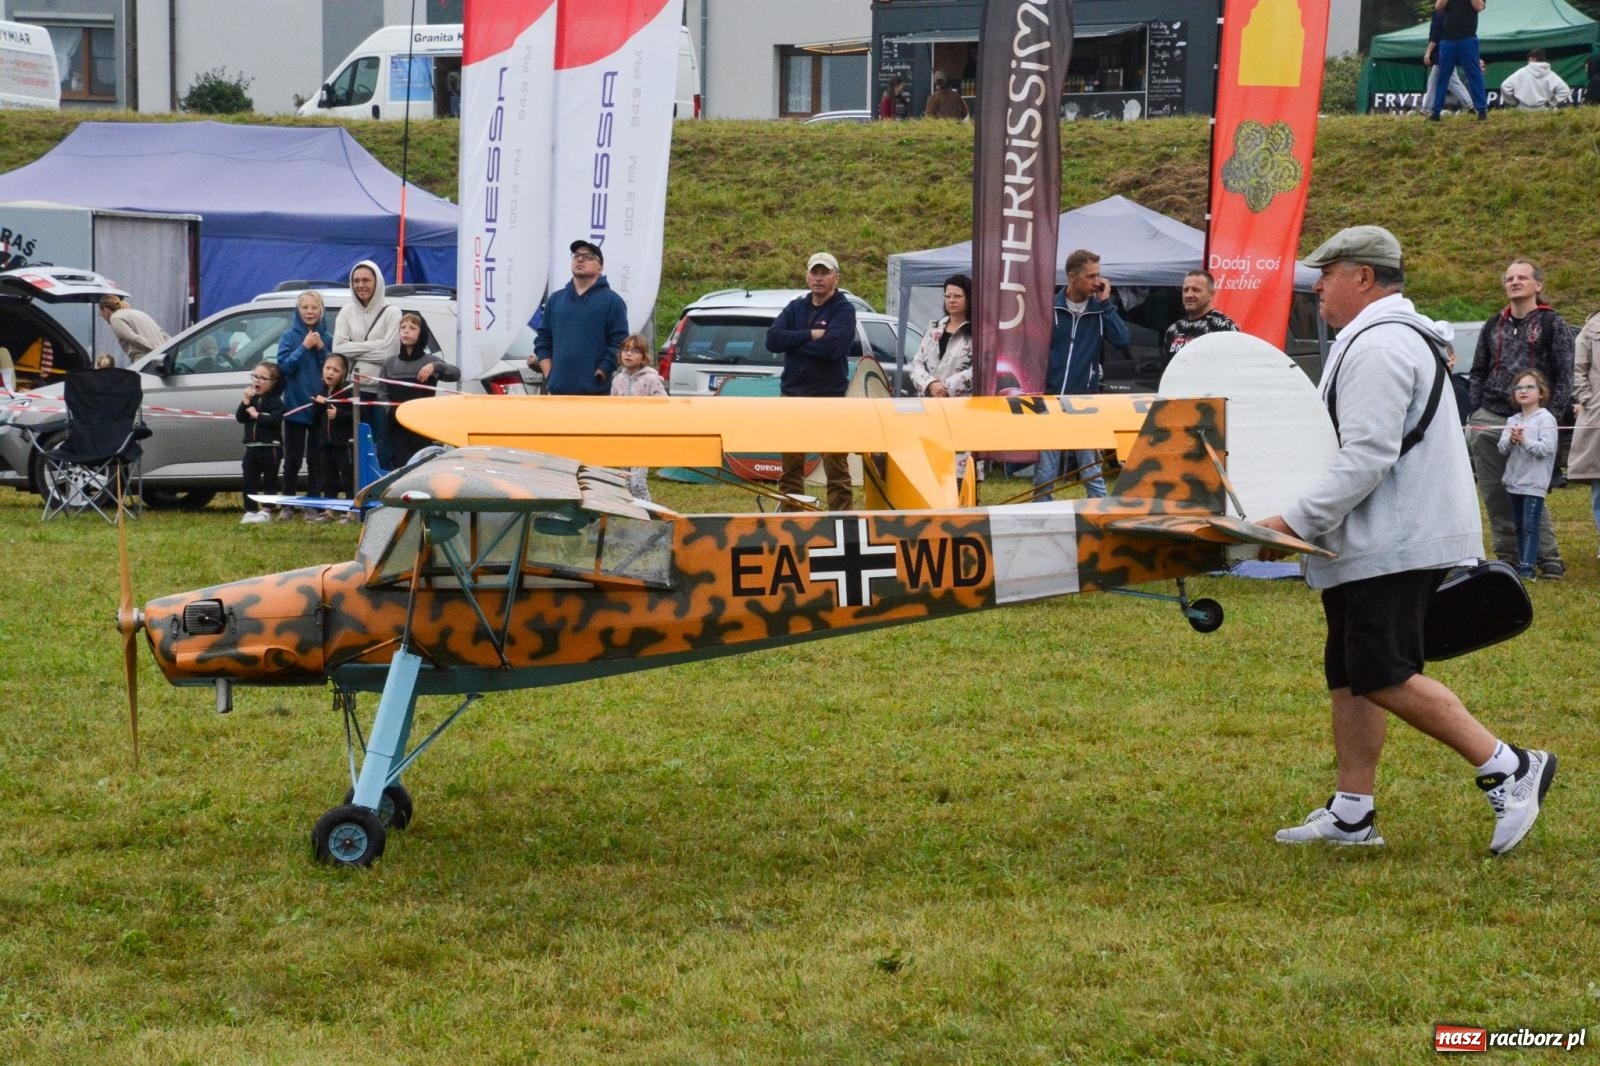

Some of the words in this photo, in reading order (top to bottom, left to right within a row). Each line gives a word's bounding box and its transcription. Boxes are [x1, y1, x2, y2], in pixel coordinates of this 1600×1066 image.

[414, 32, 454, 43] Granita
[635, 50, 644, 79] FM
[627, 154, 640, 183] FM
[623, 190, 637, 237] 100.3
[1209, 254, 1251, 274] Dodaj
[1256, 256, 1281, 269] coś
[474, 236, 482, 331] RADIO
[620, 265, 631, 293] FM
[1214, 273, 1225, 290] d
[731, 545, 806, 597] EA
[900, 536, 986, 589] WD
